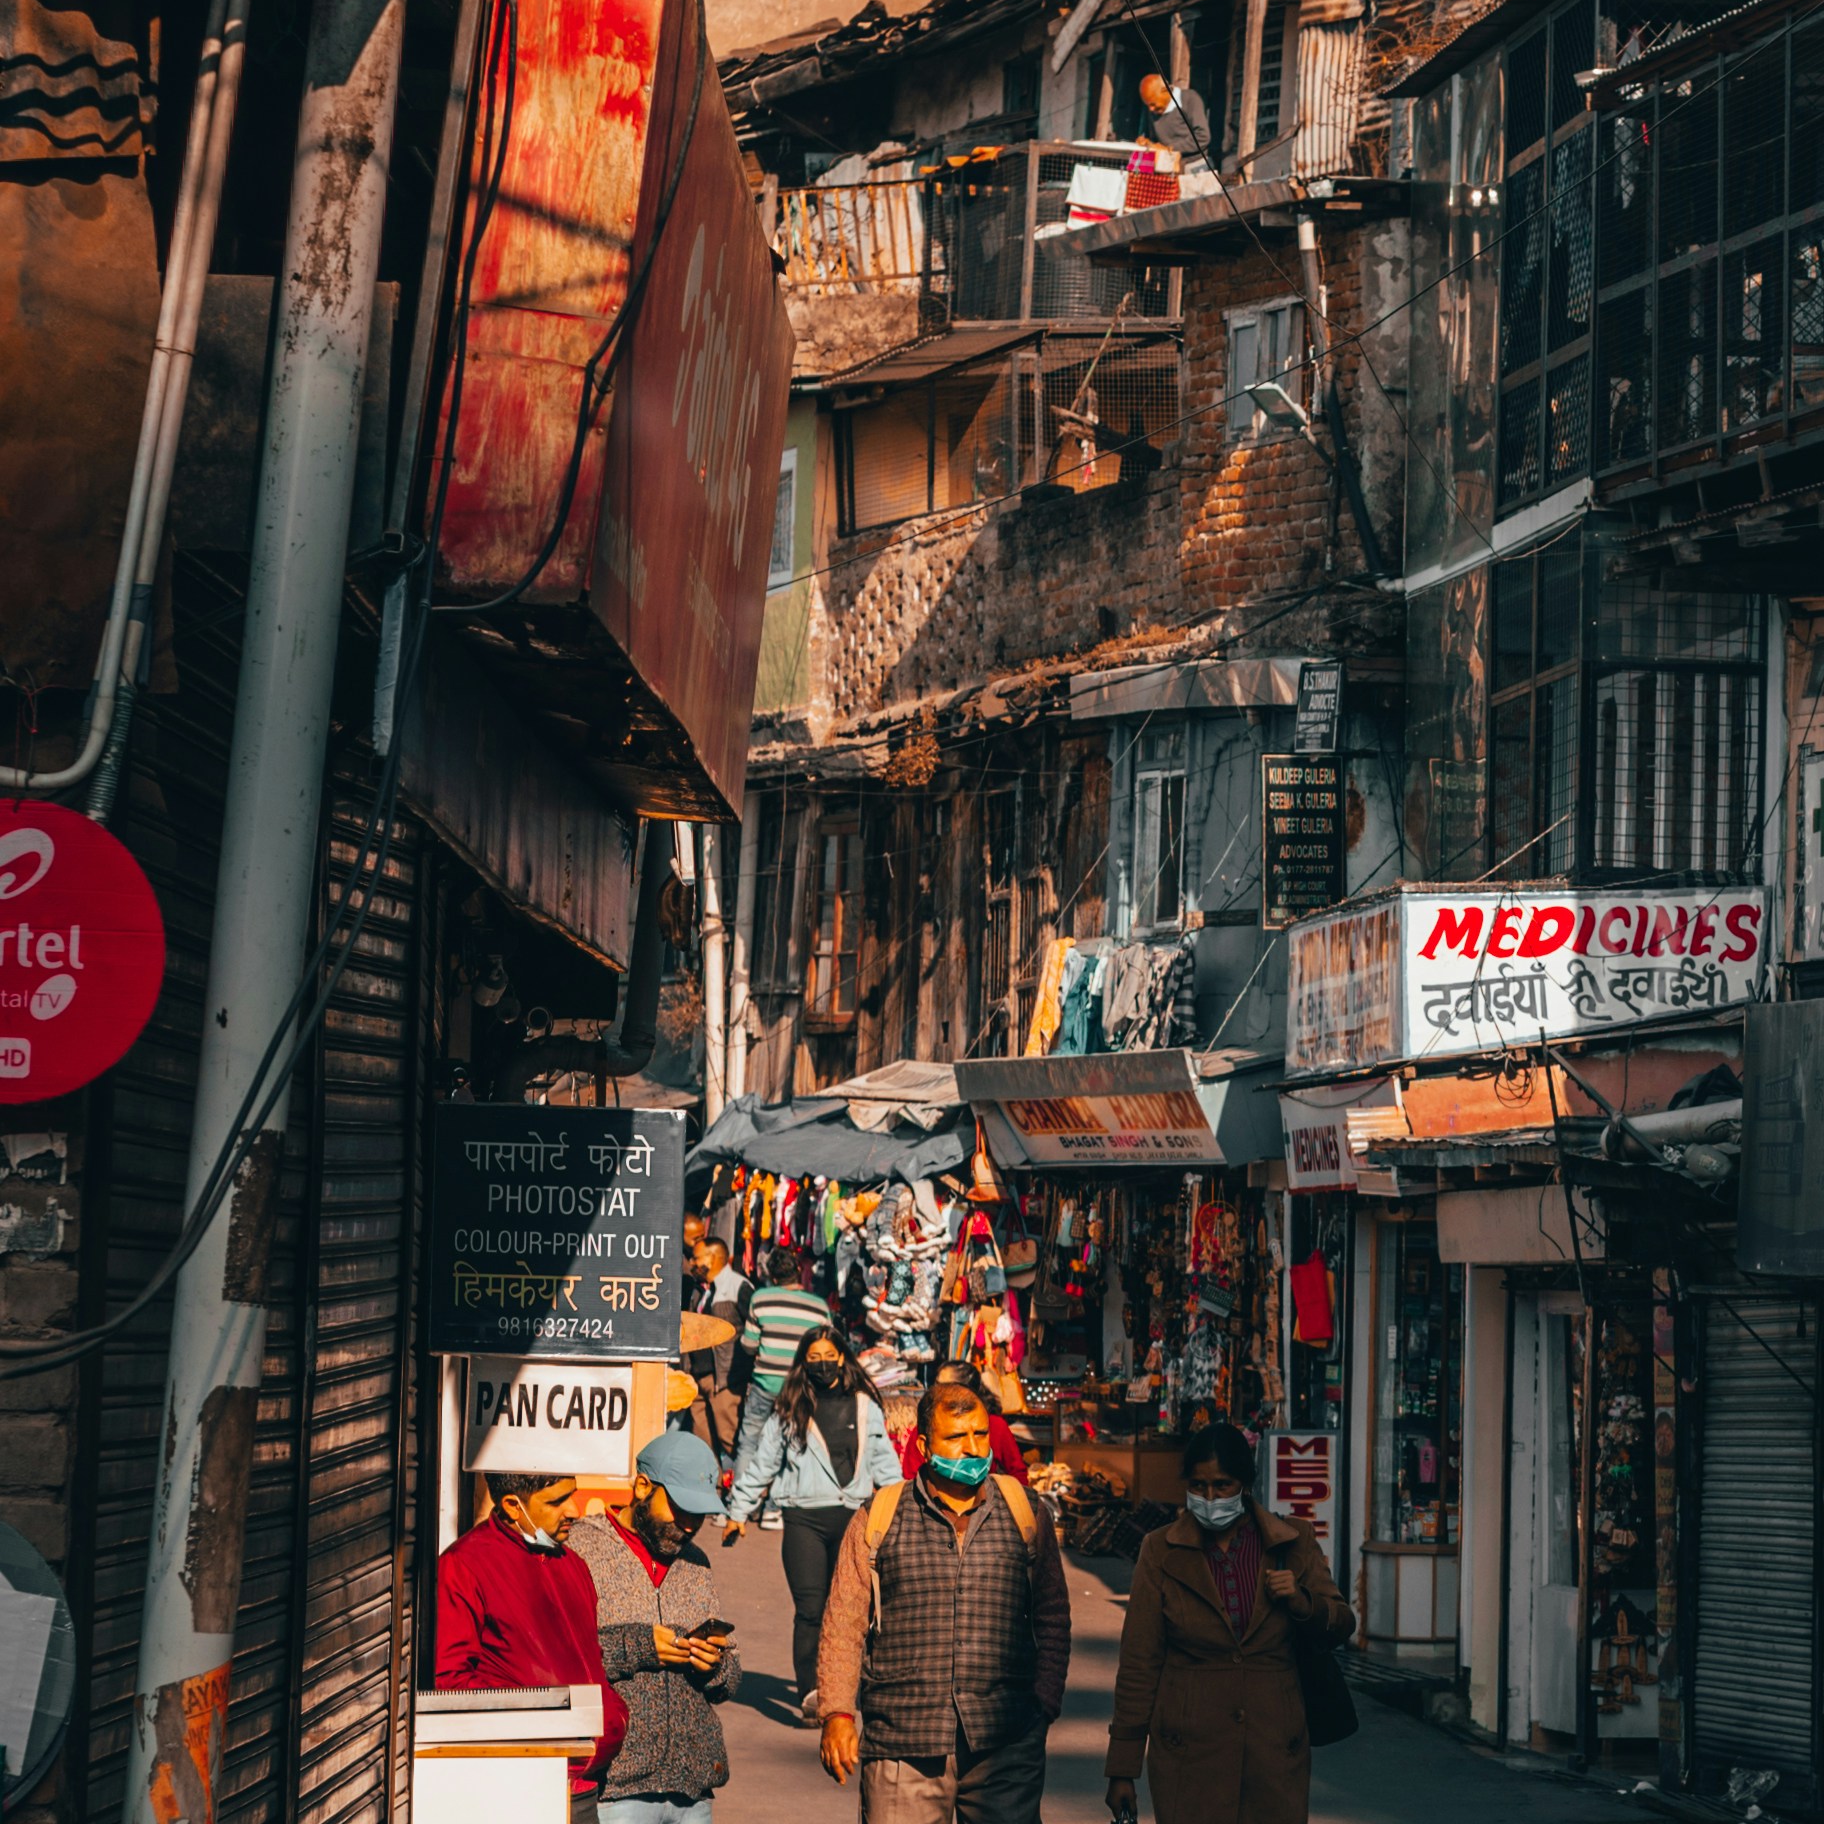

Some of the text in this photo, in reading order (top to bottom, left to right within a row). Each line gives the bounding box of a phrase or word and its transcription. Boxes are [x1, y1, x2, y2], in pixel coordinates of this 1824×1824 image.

[1269, 767, 1337, 785] KULDEEP GULERIA
[1305, 792, 1337, 810] GULERIA
[1301, 817, 1334, 835] GULERIA
[1279, 844, 1328, 859] ADVOCATES
[1416, 904, 1762, 964] MEDICINES
[36, 992, 62, 1010] TV
[1005, 1096, 1104, 1134] CHANNA
[463, 1132, 656, 1177] पासपोर्ट फोटो
[1059, 1135, 1204, 1149] BHAGAT SINGH & SONS
[1292, 1123, 1340, 1173] MEDICINES
[487, 1184, 641, 1217] PHOTOSTAT
[454, 1229, 670, 1259] COLOUR-PRINT OUT
[452, 1260, 663, 1313] हिमकेयर कार्ड
[498, 1317, 614, 1340] 9816327424
[475, 1380, 629, 1431] PAN CARD
